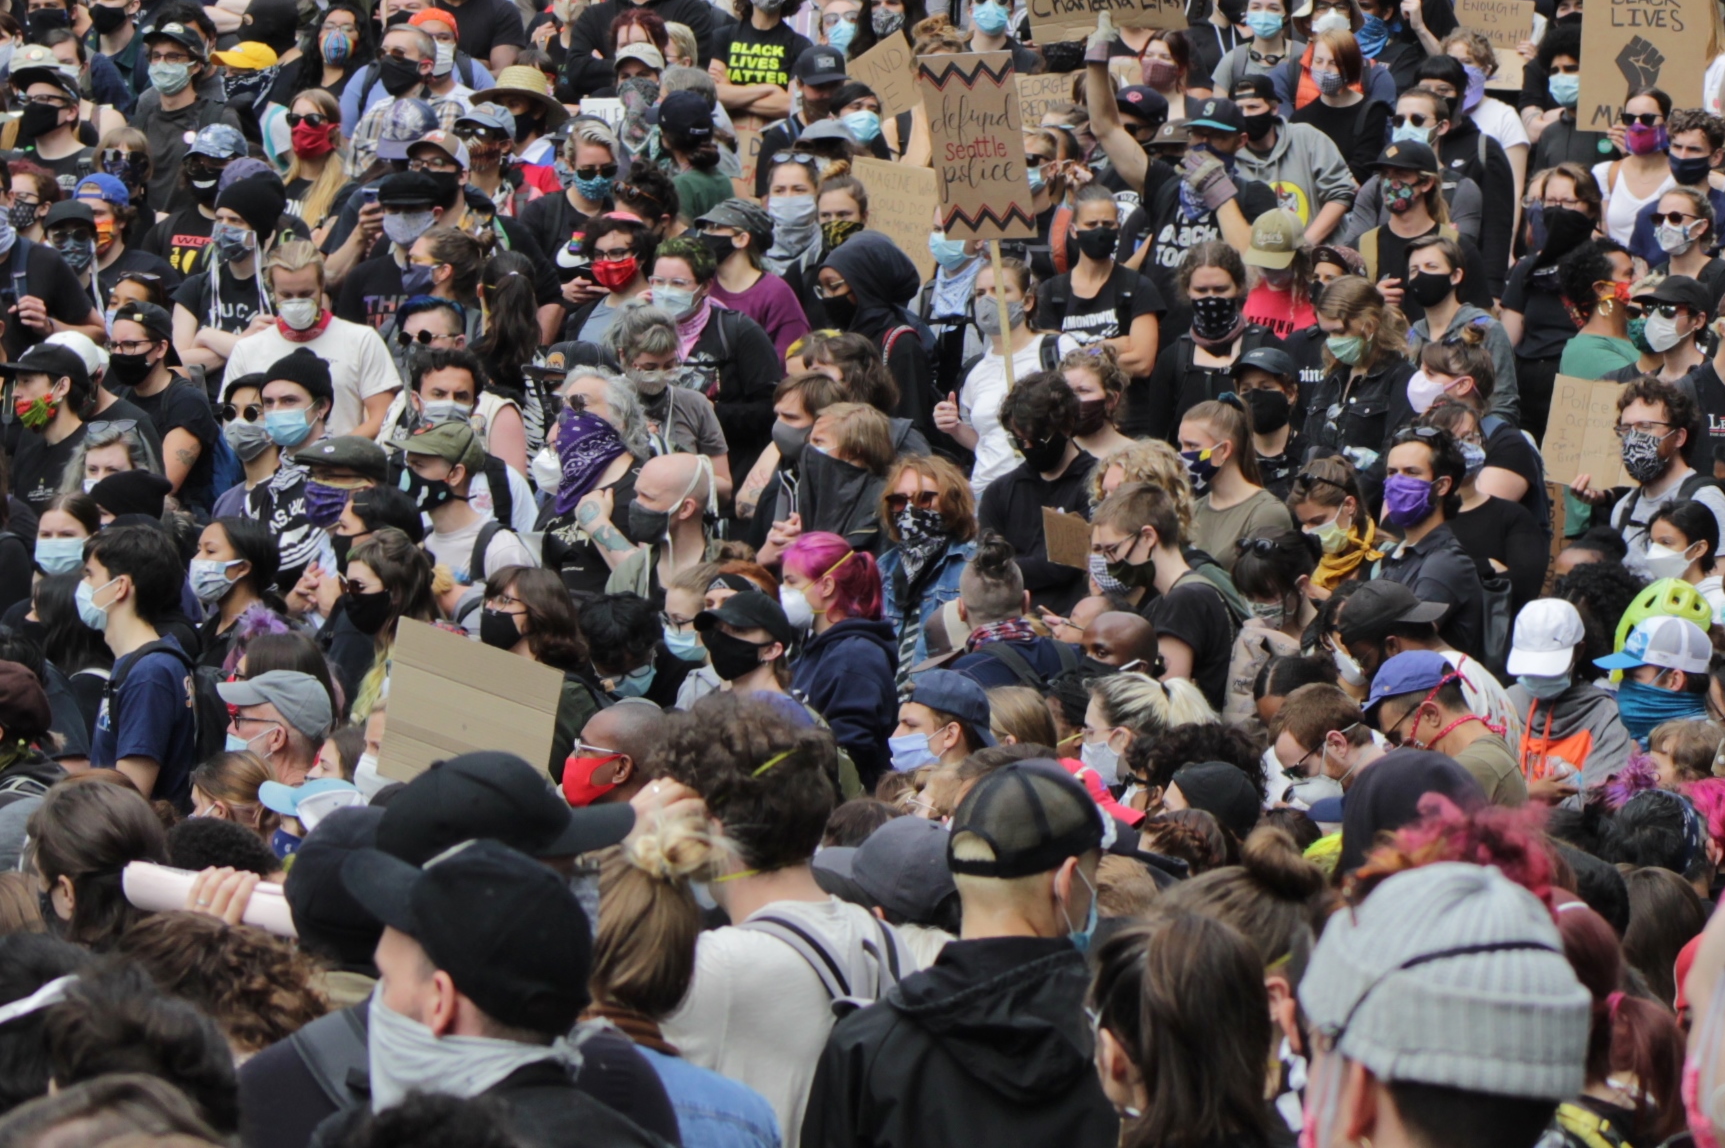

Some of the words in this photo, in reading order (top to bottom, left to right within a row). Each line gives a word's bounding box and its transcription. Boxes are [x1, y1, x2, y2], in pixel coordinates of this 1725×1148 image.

[1483, 14, 1498, 24] IS
[1610, 7, 1685, 33] LIVES
[730, 41, 785, 58] BLACK
[729, 54, 780, 71] LIVES
[1020, 74, 1071, 99] EORGE
[930, 93, 1020, 140] defund
[941, 154, 1023, 204] police
[1560, 385, 1610, 414] Police
